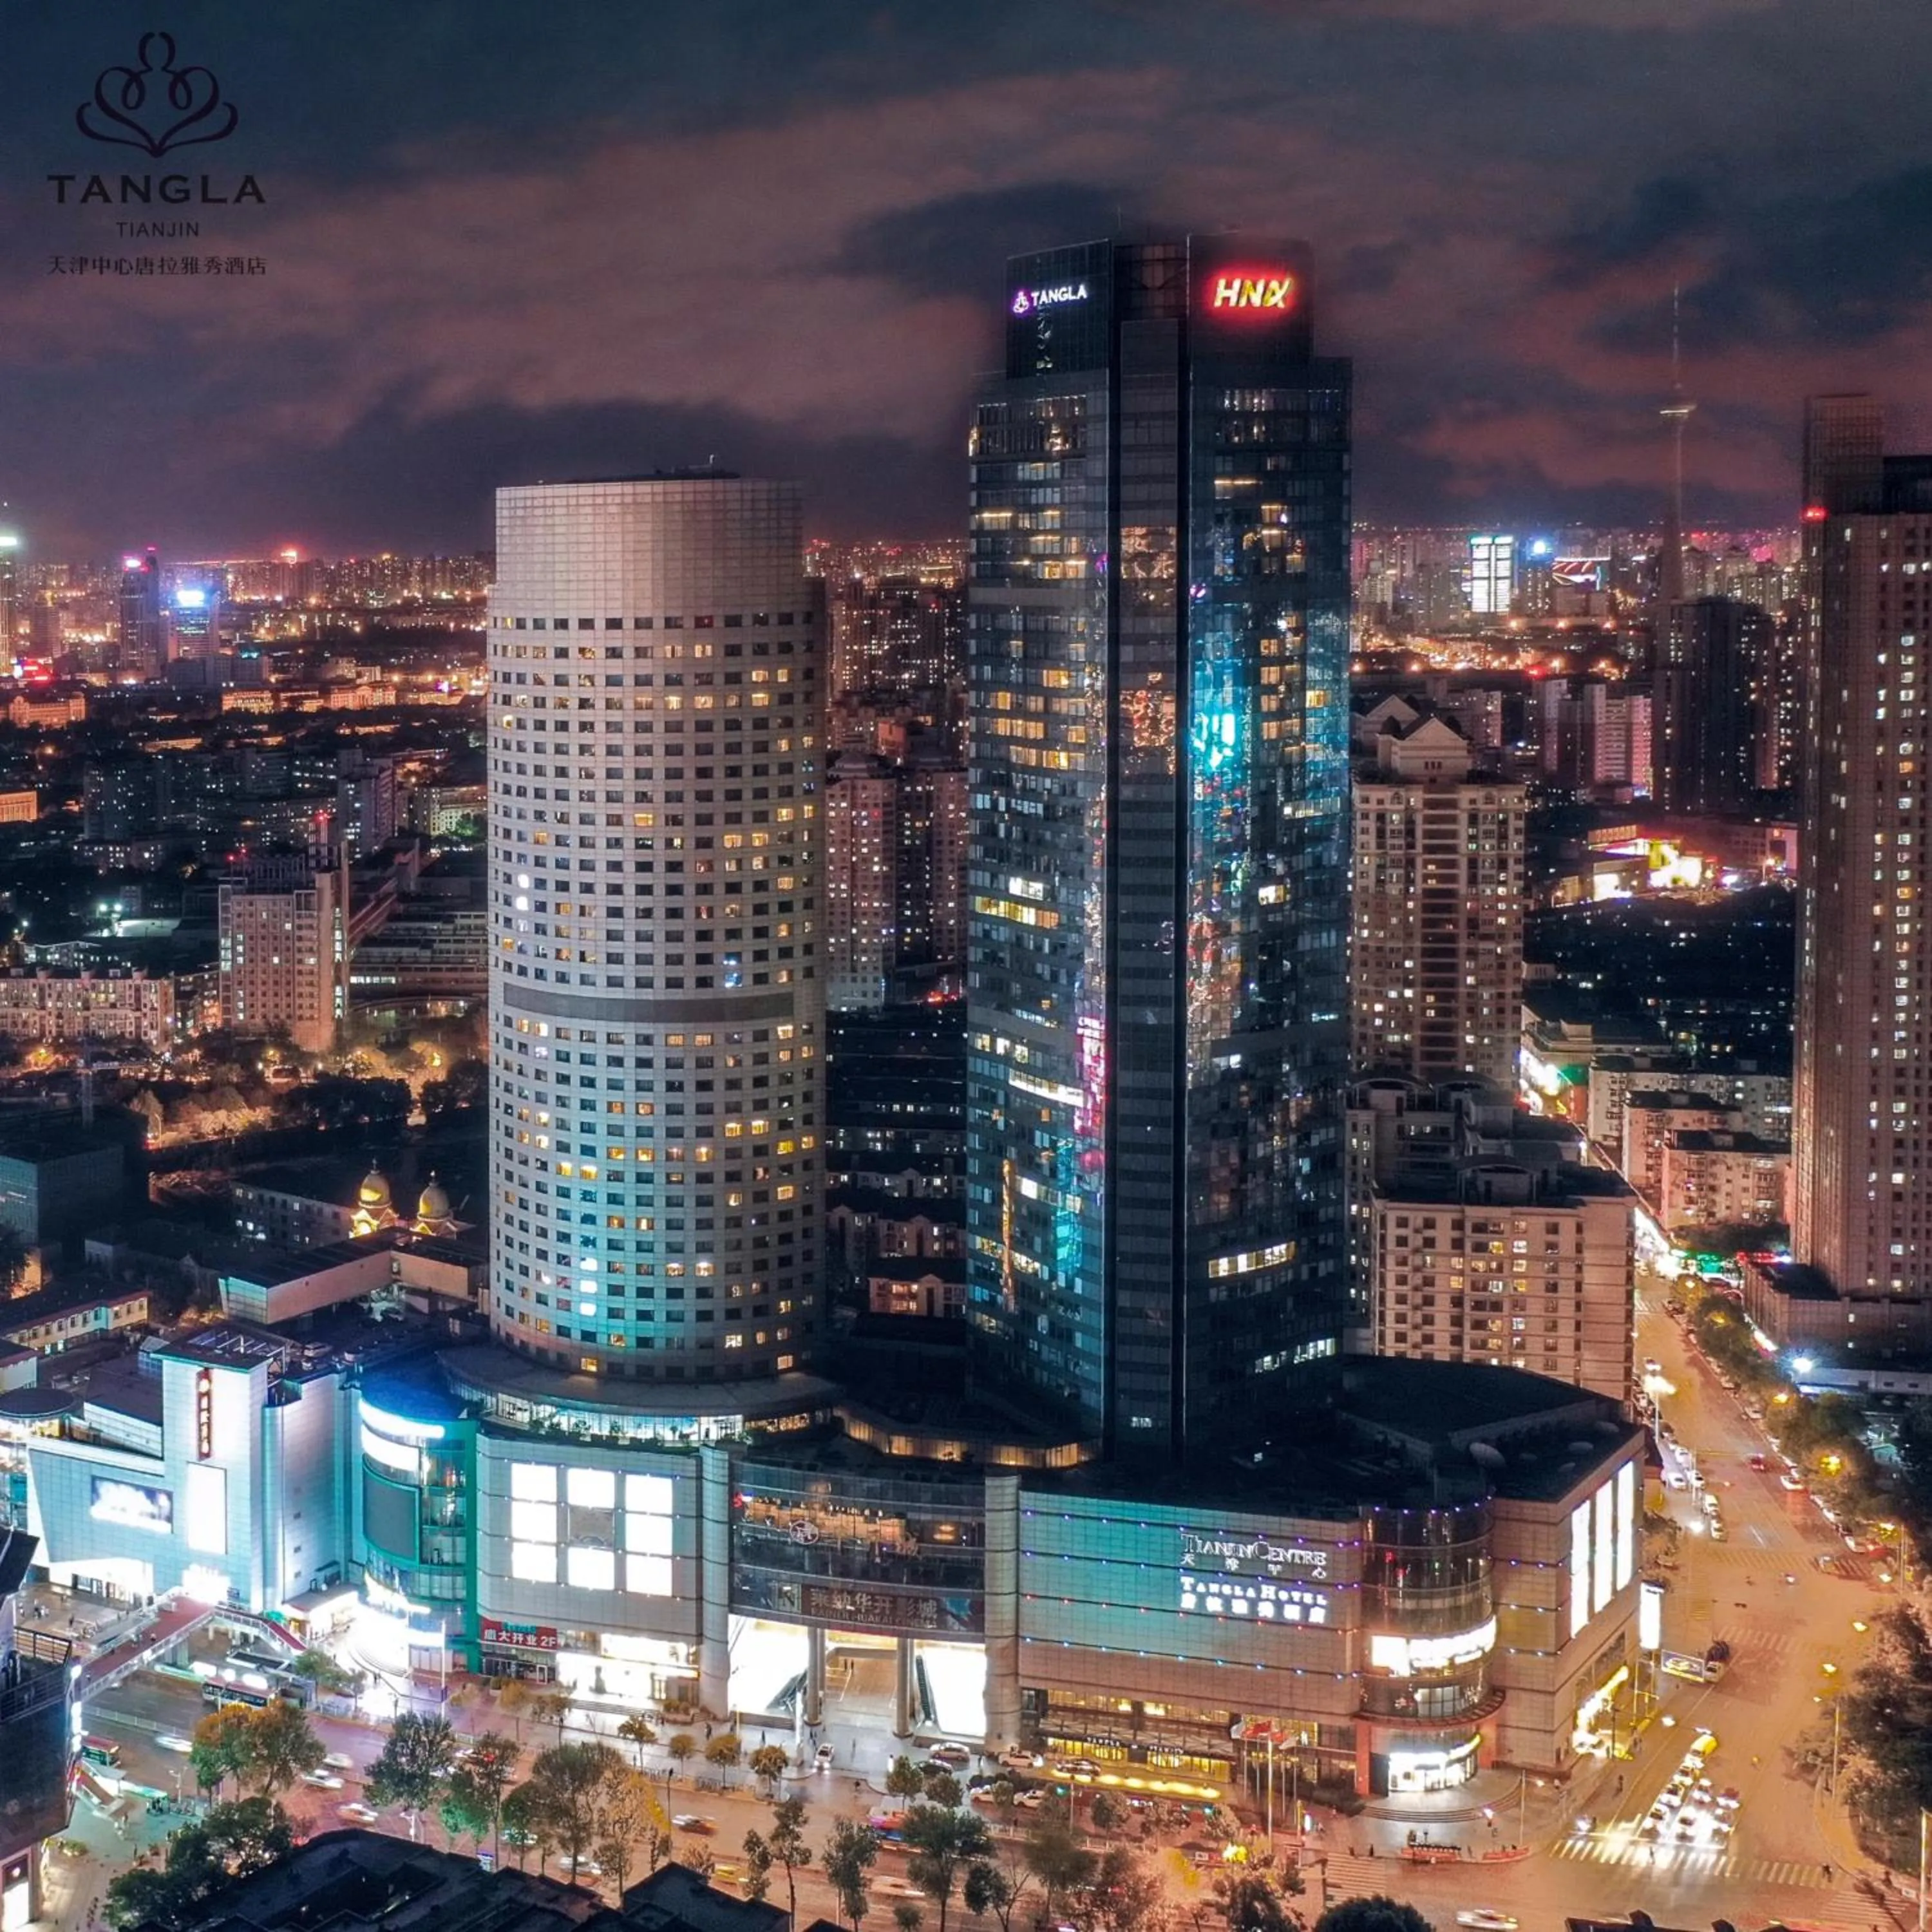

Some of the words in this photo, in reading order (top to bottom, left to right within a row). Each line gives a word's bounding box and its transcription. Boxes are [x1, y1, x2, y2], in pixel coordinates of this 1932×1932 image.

[1030, 283, 1087, 306] TANGLA
[1253, 1541, 1327, 1566] CENTRE
[1180, 1576, 1256, 1598] TANGLA
[1260, 1584, 1327, 1605] HOTEL
